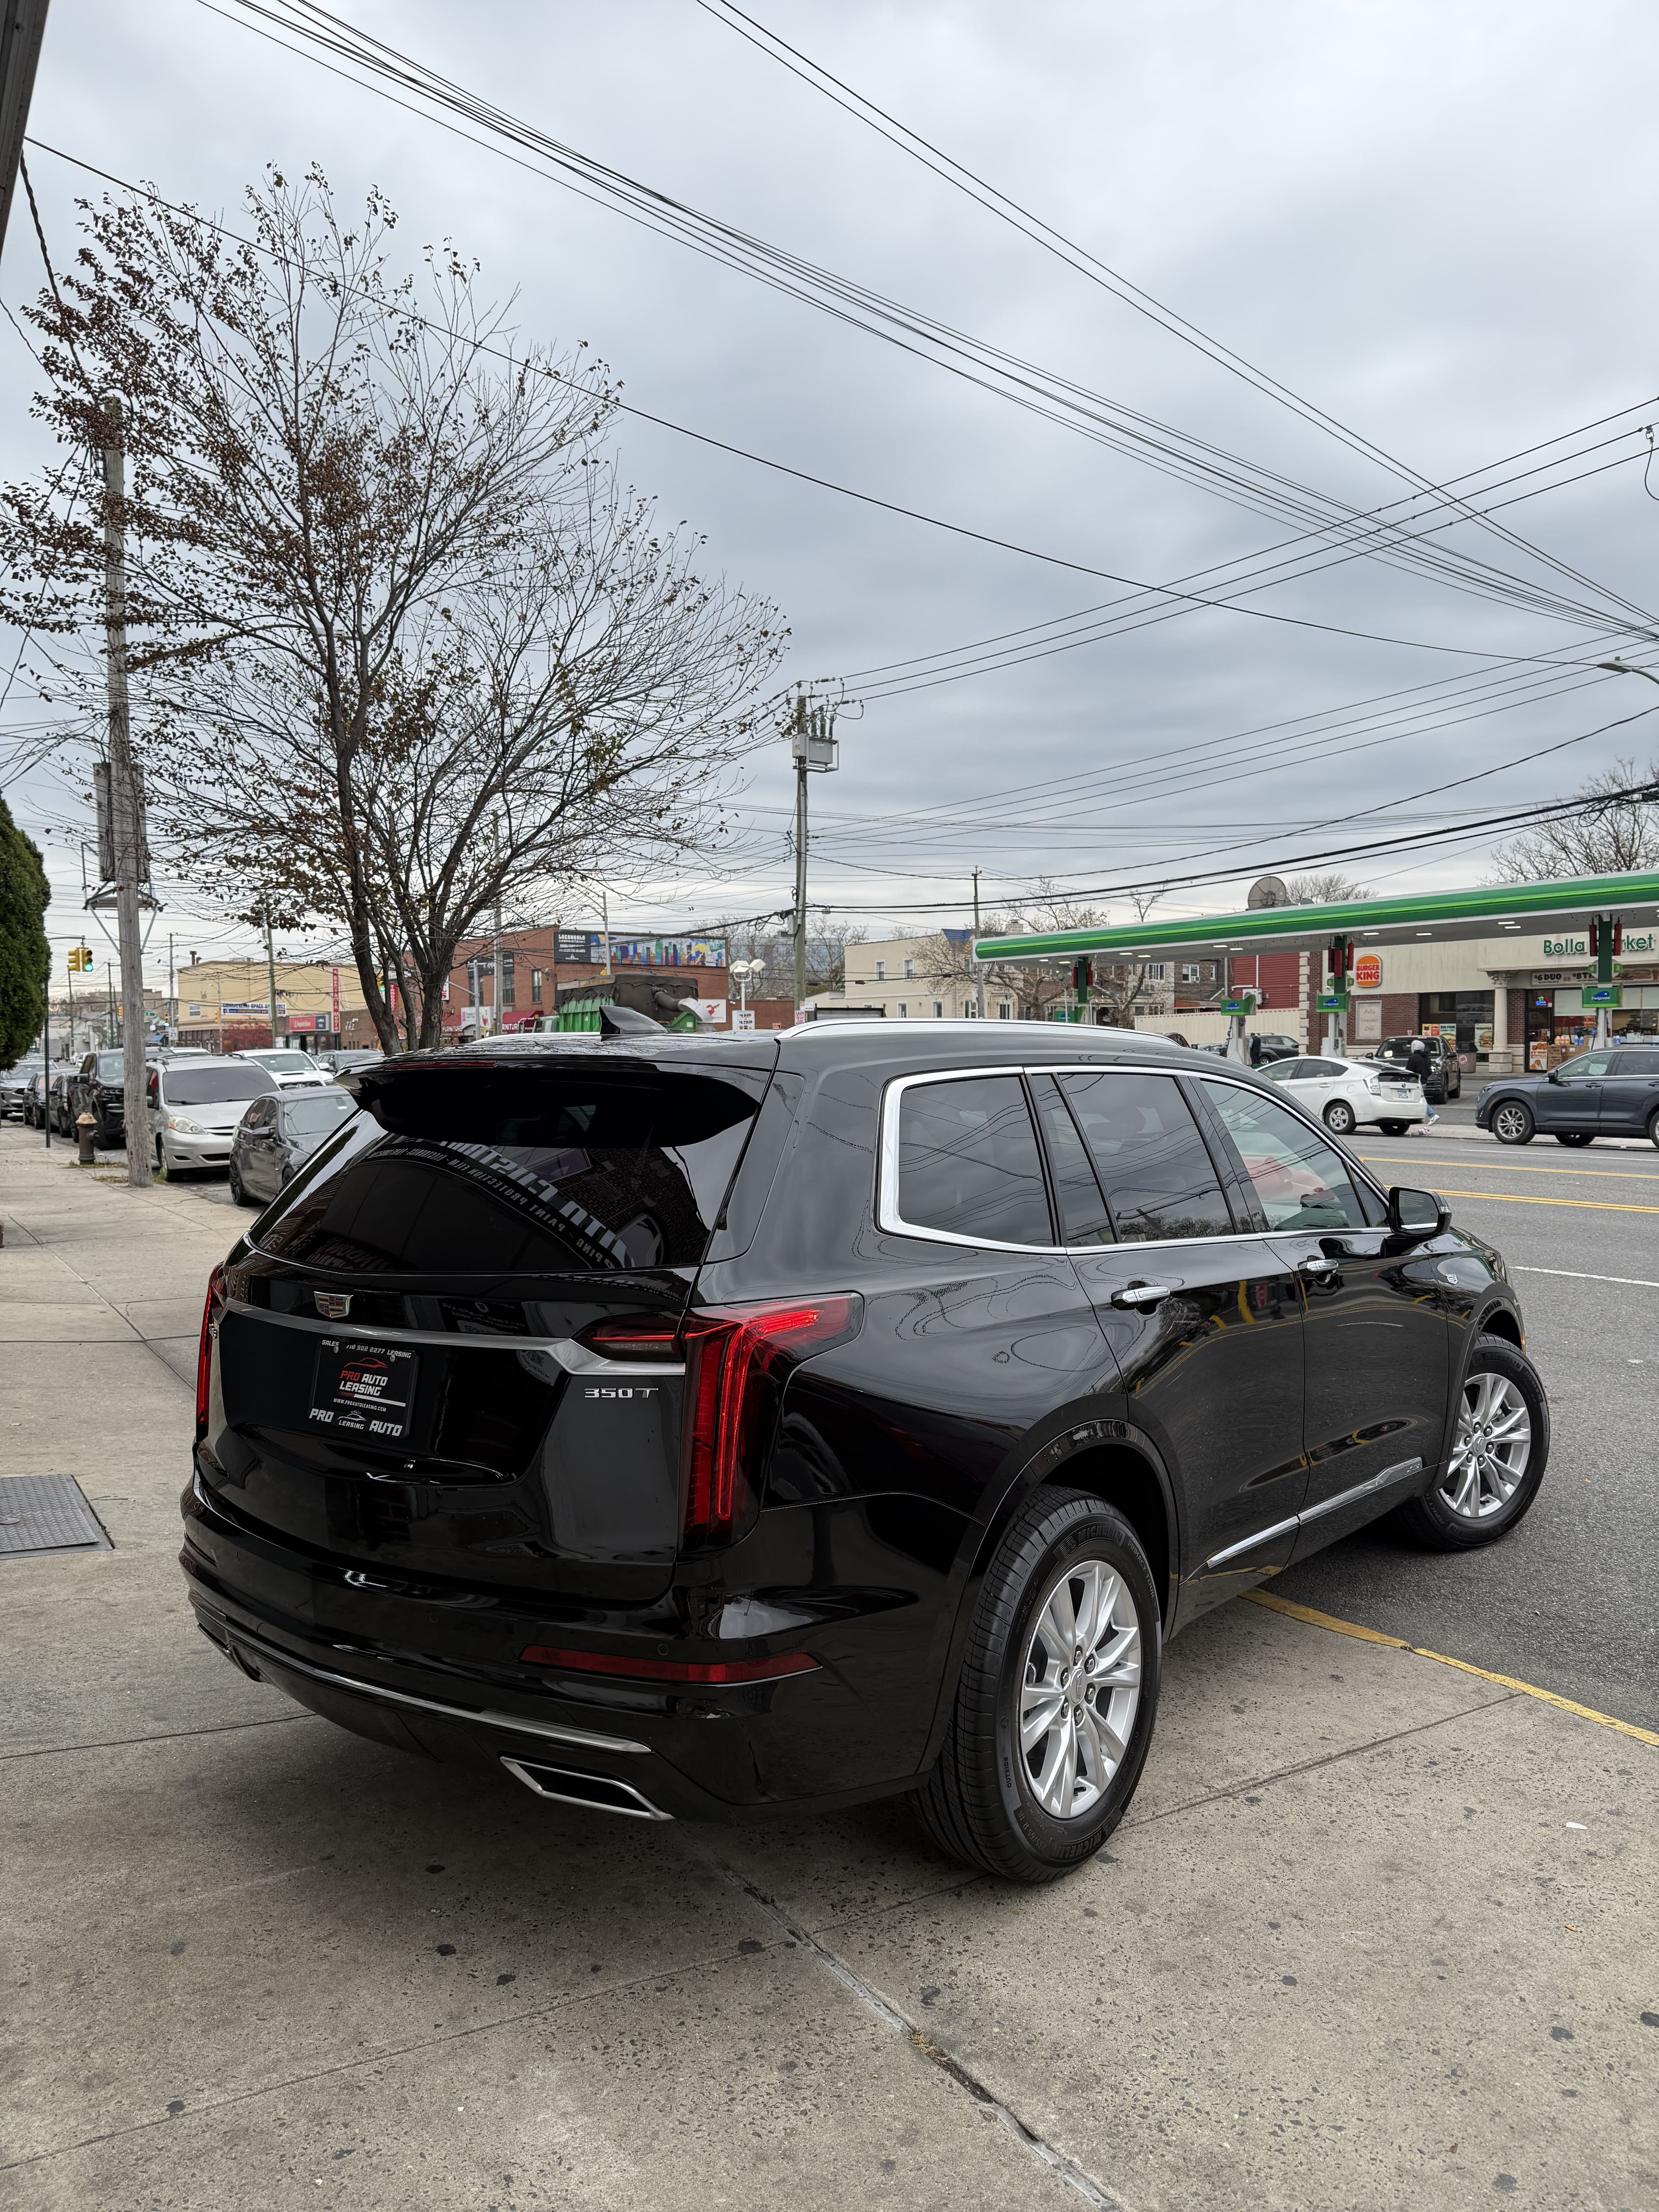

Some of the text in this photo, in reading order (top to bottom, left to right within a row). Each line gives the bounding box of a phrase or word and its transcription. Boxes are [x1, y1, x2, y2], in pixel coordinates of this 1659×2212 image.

[1544, 939, 1586, 953] Bolla
[1356, 971, 1379, 981] KING
[387, 1349, 412, 1358] LEASING
[340, 1370, 388, 1386] PRO AUTO
[339, 1381, 382, 1396] LEASING
[309, 1408, 335, 1422] PRO
[338, 1420, 365, 1430] LEASING
[369, 1420, 403, 1437] AUTO
[1078, 1525, 1122, 1545] MICHELIN
[1128, 1541, 1146, 1570] PRIMACY
[1146, 1573, 1156, 1599] TOUR
[1003, 1756, 1012, 1788] OUTSIDE
